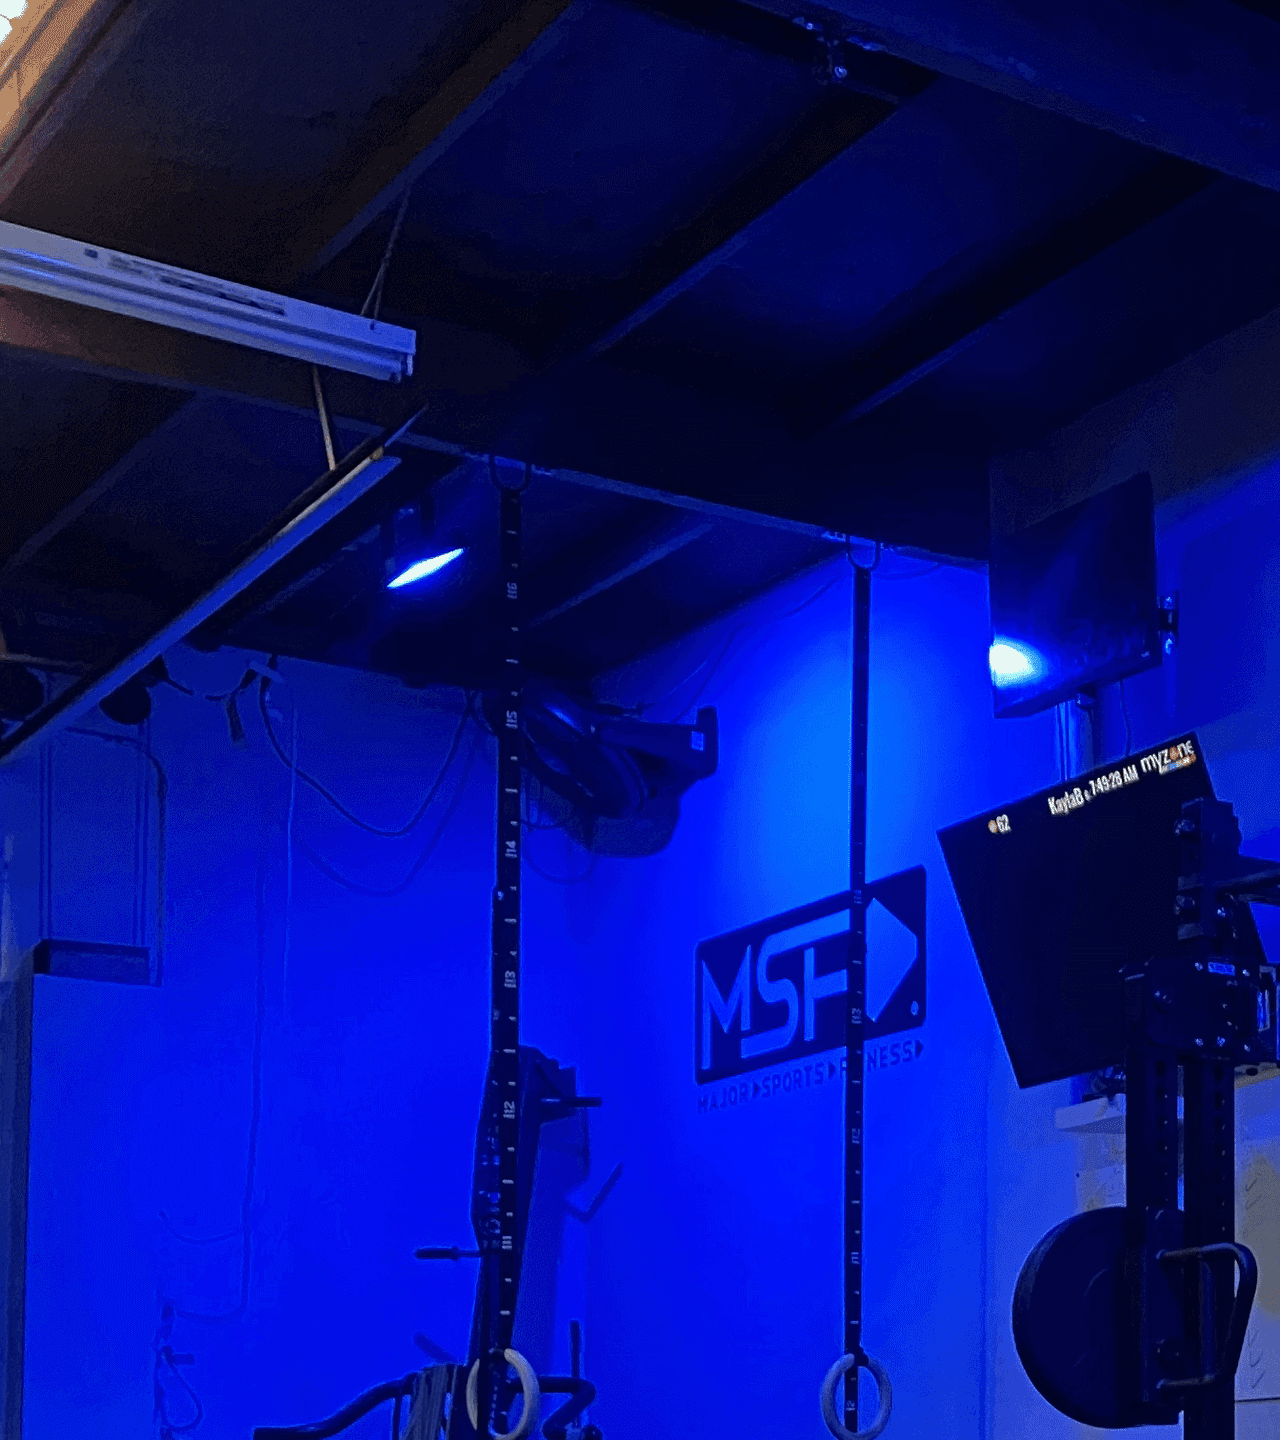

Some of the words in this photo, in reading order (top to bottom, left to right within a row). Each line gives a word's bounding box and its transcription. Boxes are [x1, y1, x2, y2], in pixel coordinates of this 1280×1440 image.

[1122, 763, 1140, 784] AM
[701, 908, 851, 1070] MSF
[761, 1062, 825, 1098] SPORTS
